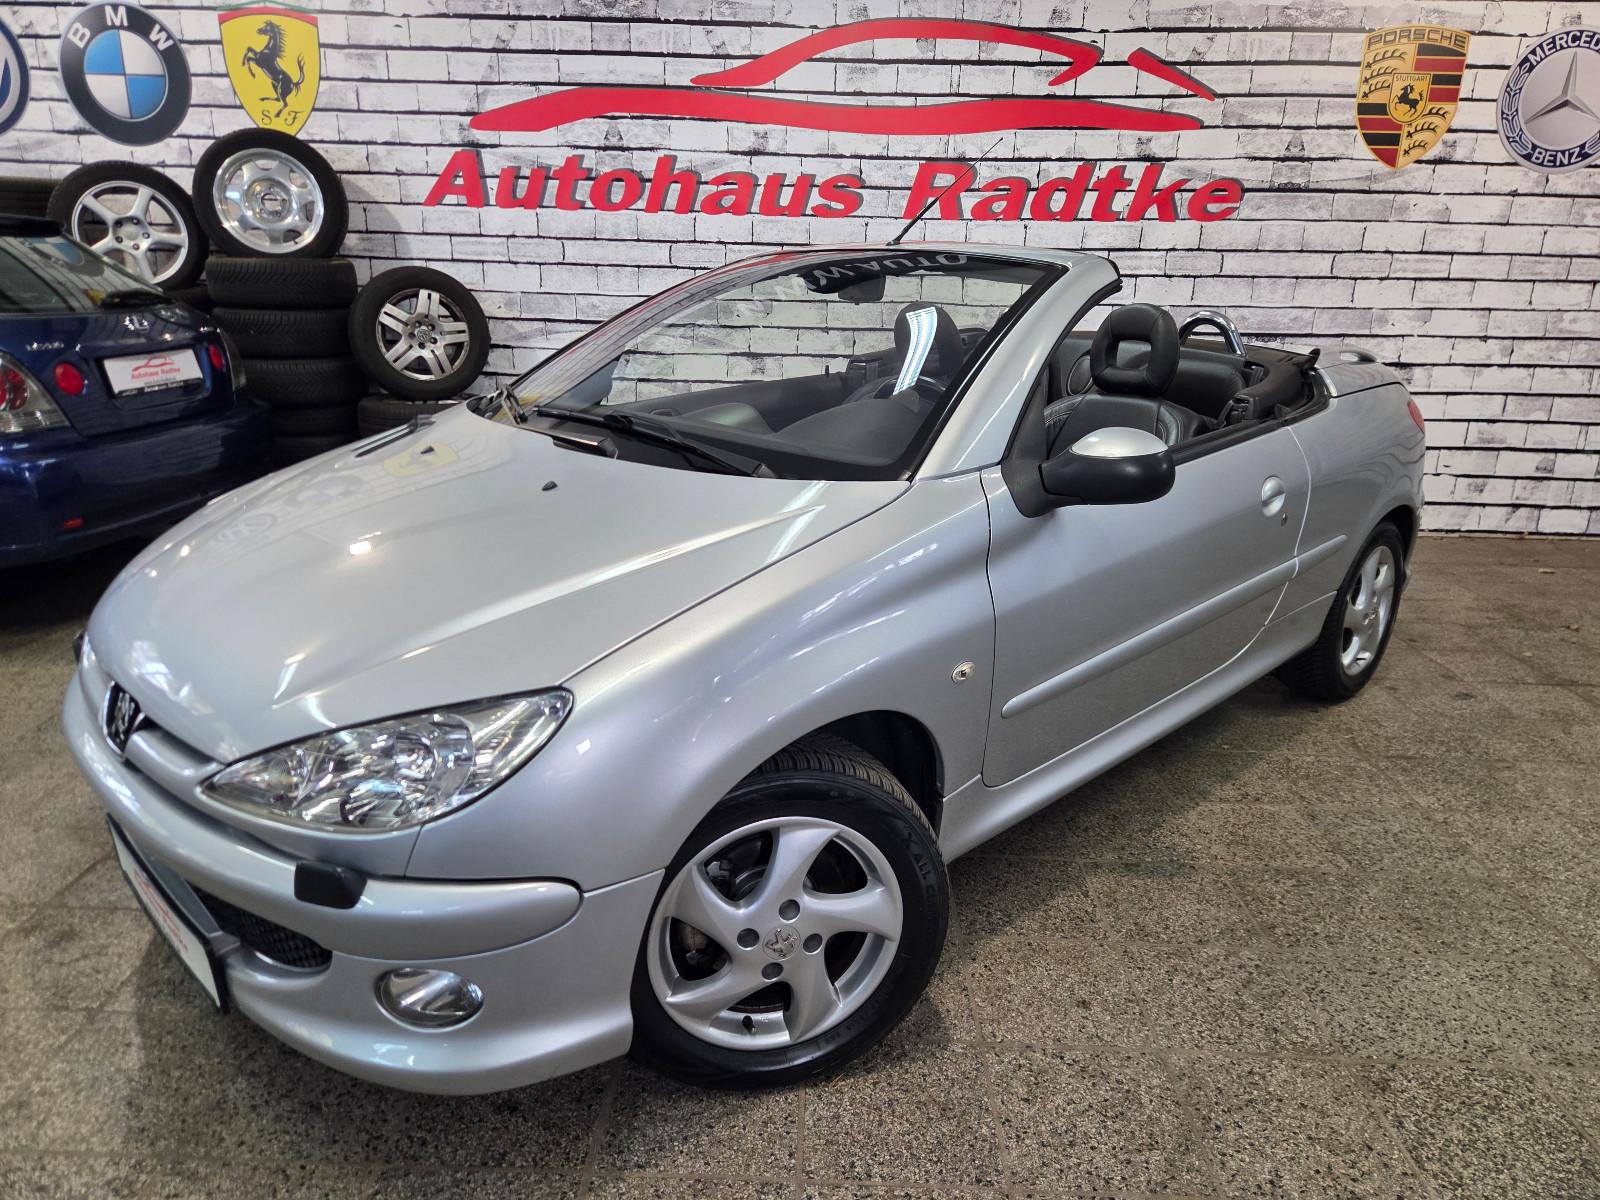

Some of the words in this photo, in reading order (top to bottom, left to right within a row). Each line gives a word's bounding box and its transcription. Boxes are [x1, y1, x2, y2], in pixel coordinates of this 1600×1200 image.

[67, 6, 174, 50] BMW
[1367, 29, 1467, 50] PORSCHE
[1530, 149, 1582, 167] BENZ
[423, 149, 863, 218] Autohaus
[902, 160, 1244, 223] Radtke
